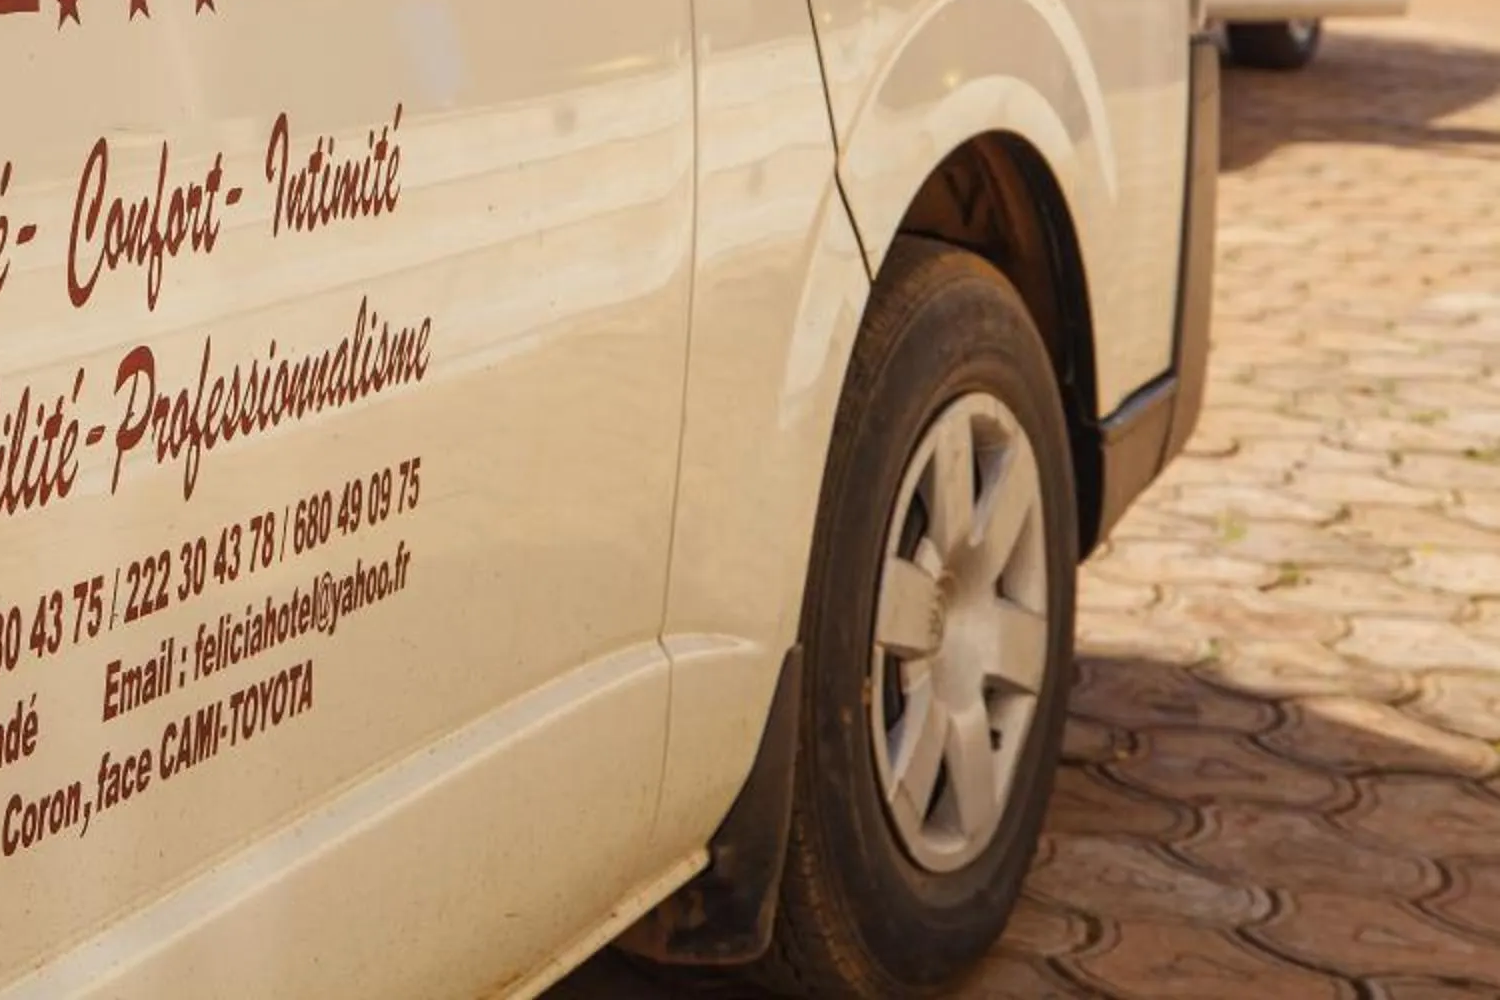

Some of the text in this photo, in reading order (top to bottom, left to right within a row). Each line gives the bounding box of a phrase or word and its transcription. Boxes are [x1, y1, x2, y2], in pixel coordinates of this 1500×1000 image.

[265, 102, 403, 238] Intimité
[28, 589, 64, 659] 43
[73, 575, 105, 644] 75
[108, 566, 121, 631] /
[123, 549, 172, 624] 222
[177, 535, 208, 602] 30
[213, 523, 242, 585] 43
[249, 511, 275, 573] 78
[279, 505, 290, 563] /
[293, 489, 333, 555] 680
[336, 478, 363, 536] 49
[367, 467, 393, 526] 09
[397, 456, 421, 514] 75
[102, 636, 175, 723] Email
[193, 540, 411, 681] feliciahotel@yahoo.fr
[95, 748, 153, 813] face
[159, 659, 313, 781] CAMI-TOYOTA
